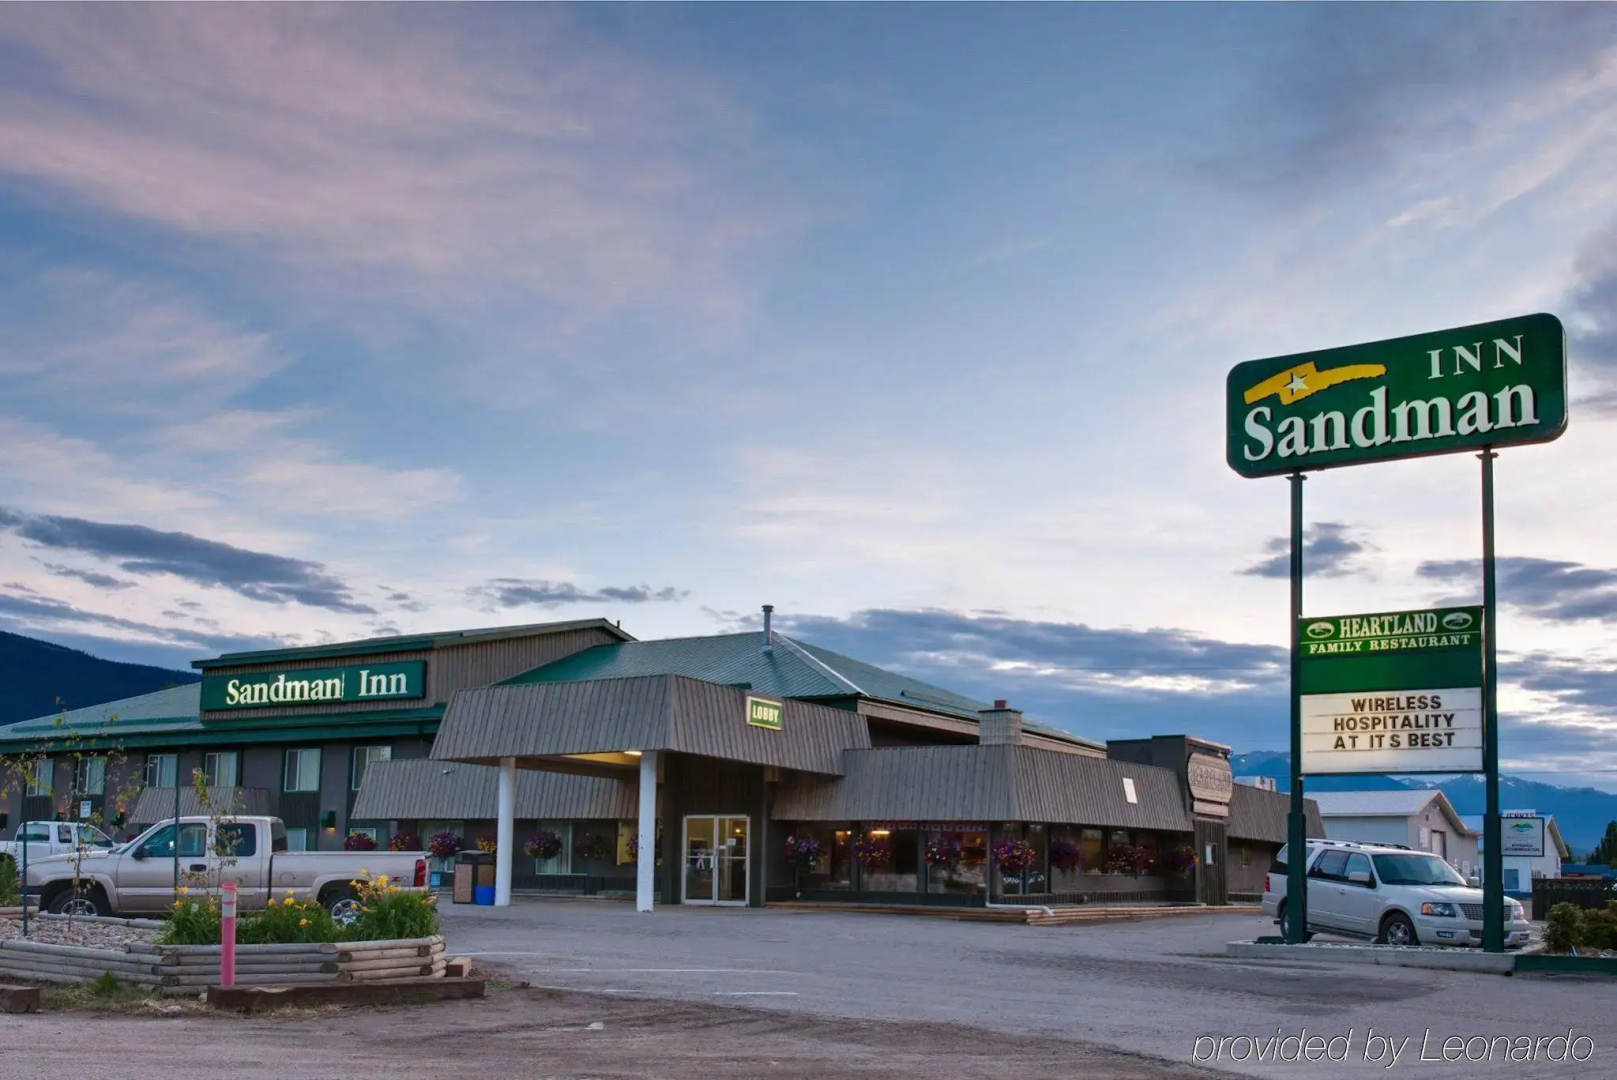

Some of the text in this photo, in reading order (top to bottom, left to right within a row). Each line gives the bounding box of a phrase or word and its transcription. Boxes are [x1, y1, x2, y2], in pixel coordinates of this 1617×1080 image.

[1427, 334, 1524, 380] INN
[1243, 383, 1540, 462] Sandman
[1339, 612, 1438, 639] HEARTLAND
[1309, 634, 1471, 654] FAMILY RESTAURANT
[226, 669, 408, 705] Sandman Inn
[752, 704, 779, 723] LOBBY
[1351, 695, 1442, 712] WIRELESS
[1333, 713, 1455, 731] HOSPITALITY
[1333, 732, 1455, 749] AT ITS BEST
